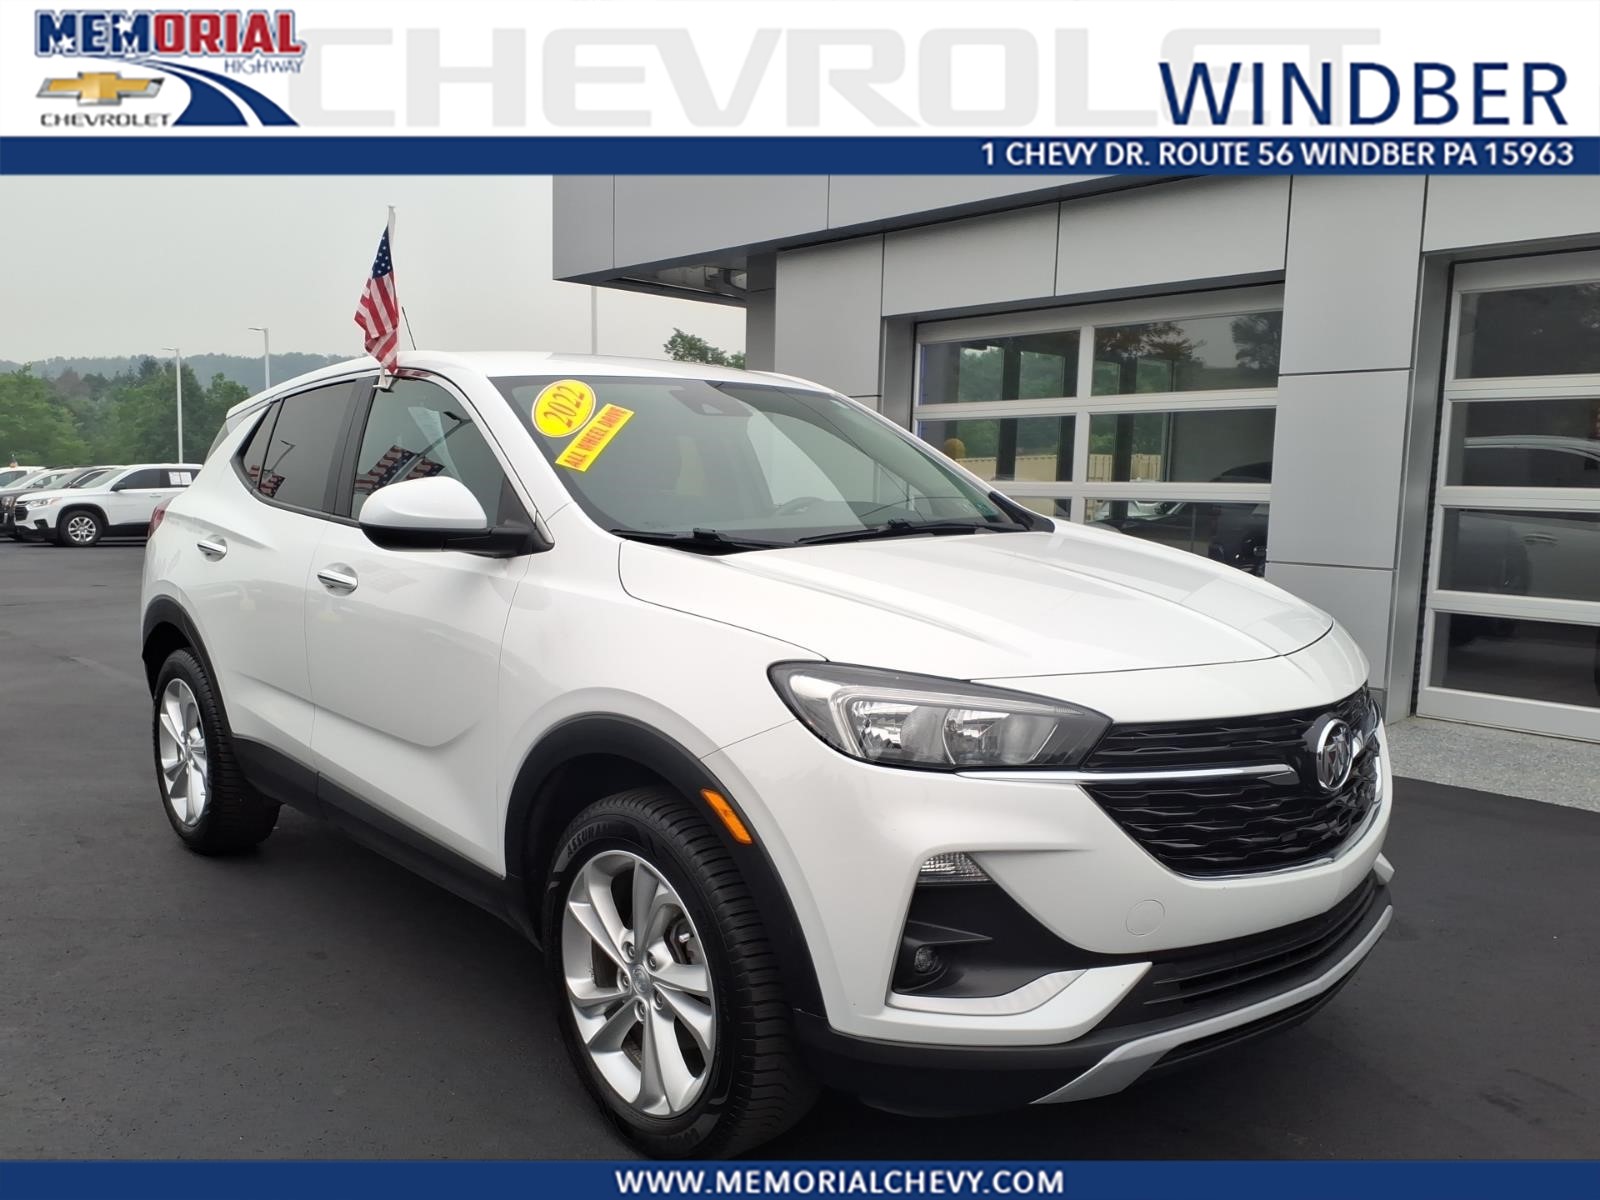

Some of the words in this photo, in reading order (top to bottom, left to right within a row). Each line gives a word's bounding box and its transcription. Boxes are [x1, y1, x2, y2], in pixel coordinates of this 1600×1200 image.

[543, 385, 585, 428] 2022
[597, 406, 628, 429] DRIVE
[575, 426, 609, 451] WHEEL
[564, 451, 587, 468] ALL
